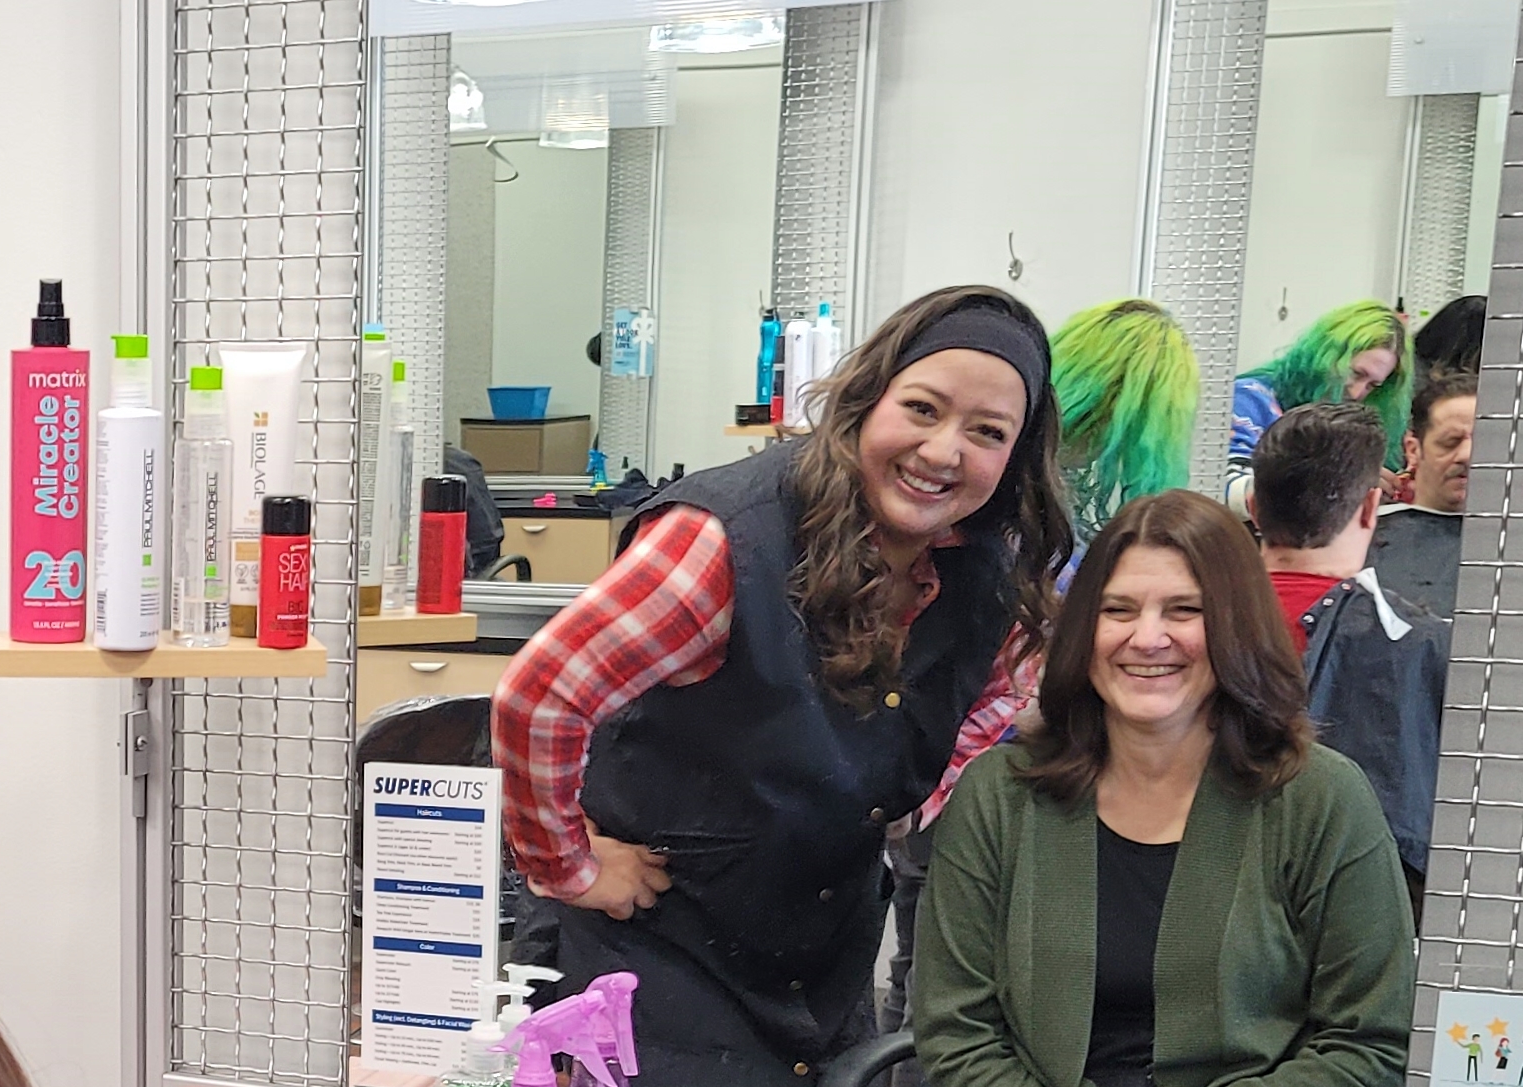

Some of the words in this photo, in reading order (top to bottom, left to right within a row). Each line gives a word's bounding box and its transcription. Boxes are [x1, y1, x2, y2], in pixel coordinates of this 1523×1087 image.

[28, 369, 87, 388] matrix
[33, 395, 59, 516] Miracle
[58, 395, 81, 519] Creator
[143, 448, 155, 513] MITCHELL
[142, 514, 154, 548] PAUL
[204, 532, 217, 562] PAUL
[23, 550, 86, 600] 20
[373, 776, 484, 800] SUPERCUTS
[419, 943, 435, 951] Color
